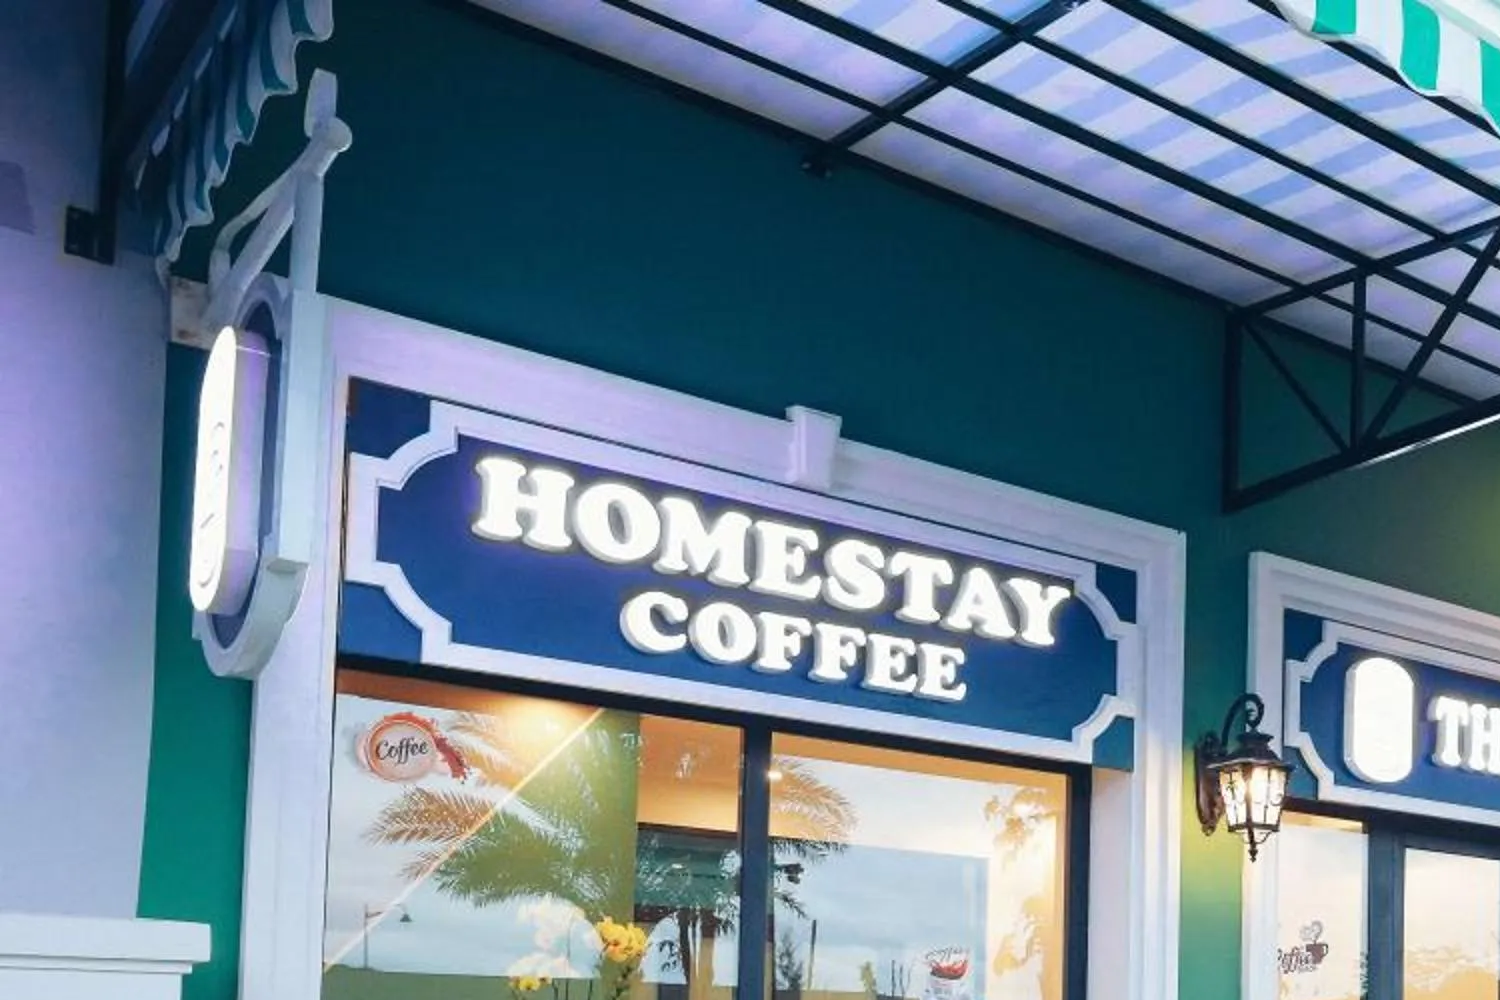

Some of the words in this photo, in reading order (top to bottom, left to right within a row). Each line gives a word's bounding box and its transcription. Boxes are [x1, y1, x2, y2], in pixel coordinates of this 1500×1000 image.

[471, 456, 1071, 647] HOMESTAY
[619, 591, 967, 703] COFFEE
[375, 736, 429, 766] Coffee
